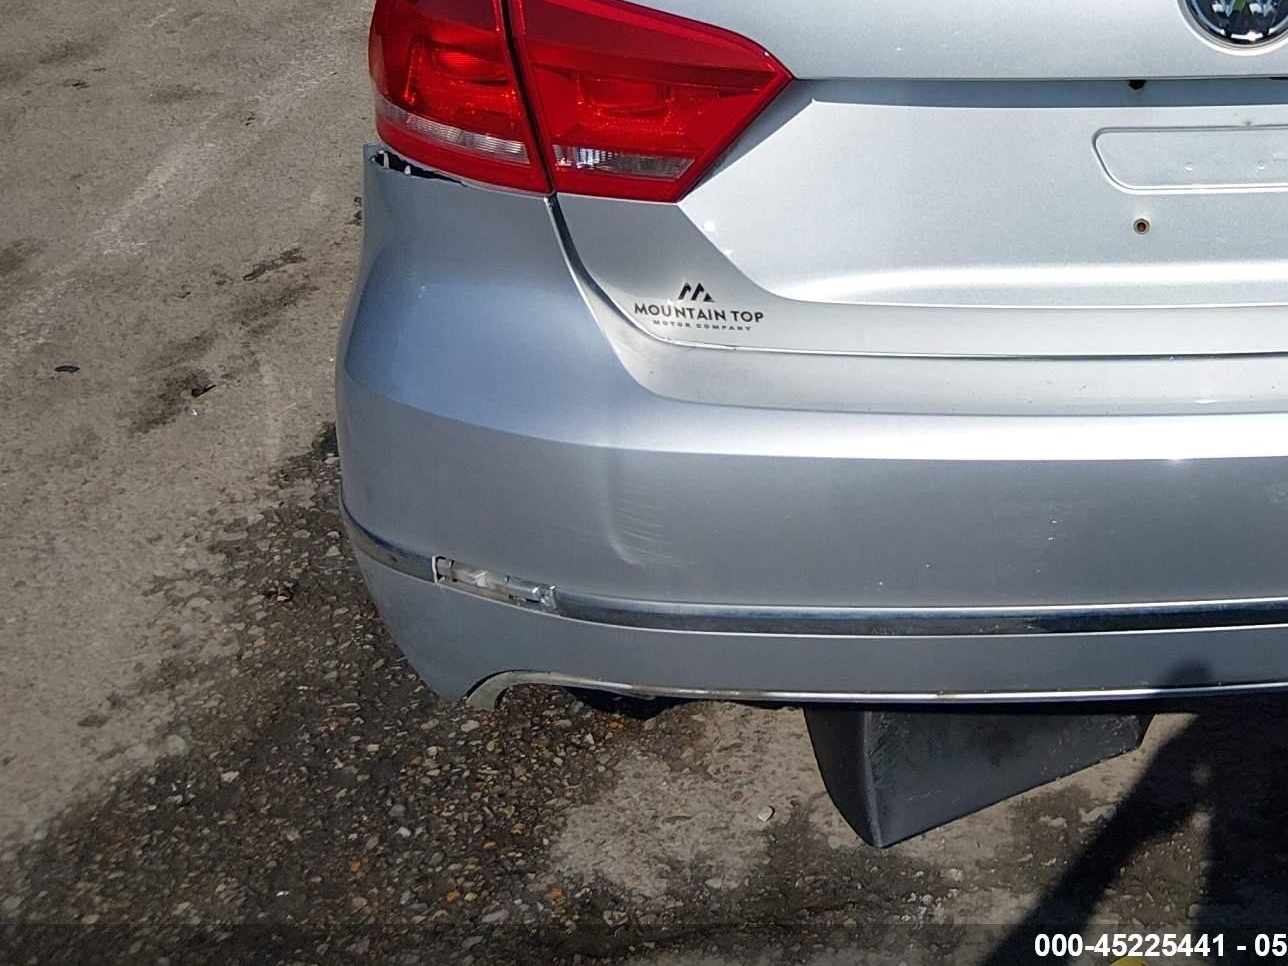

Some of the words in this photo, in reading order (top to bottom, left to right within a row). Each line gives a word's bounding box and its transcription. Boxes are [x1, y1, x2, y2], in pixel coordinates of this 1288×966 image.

[634, 303, 727, 321] MOUNTAIN
[730, 310, 764, 323] TOP
[652, 319, 691, 328] MOTOR
[696, 323, 751, 331] COMPANY
